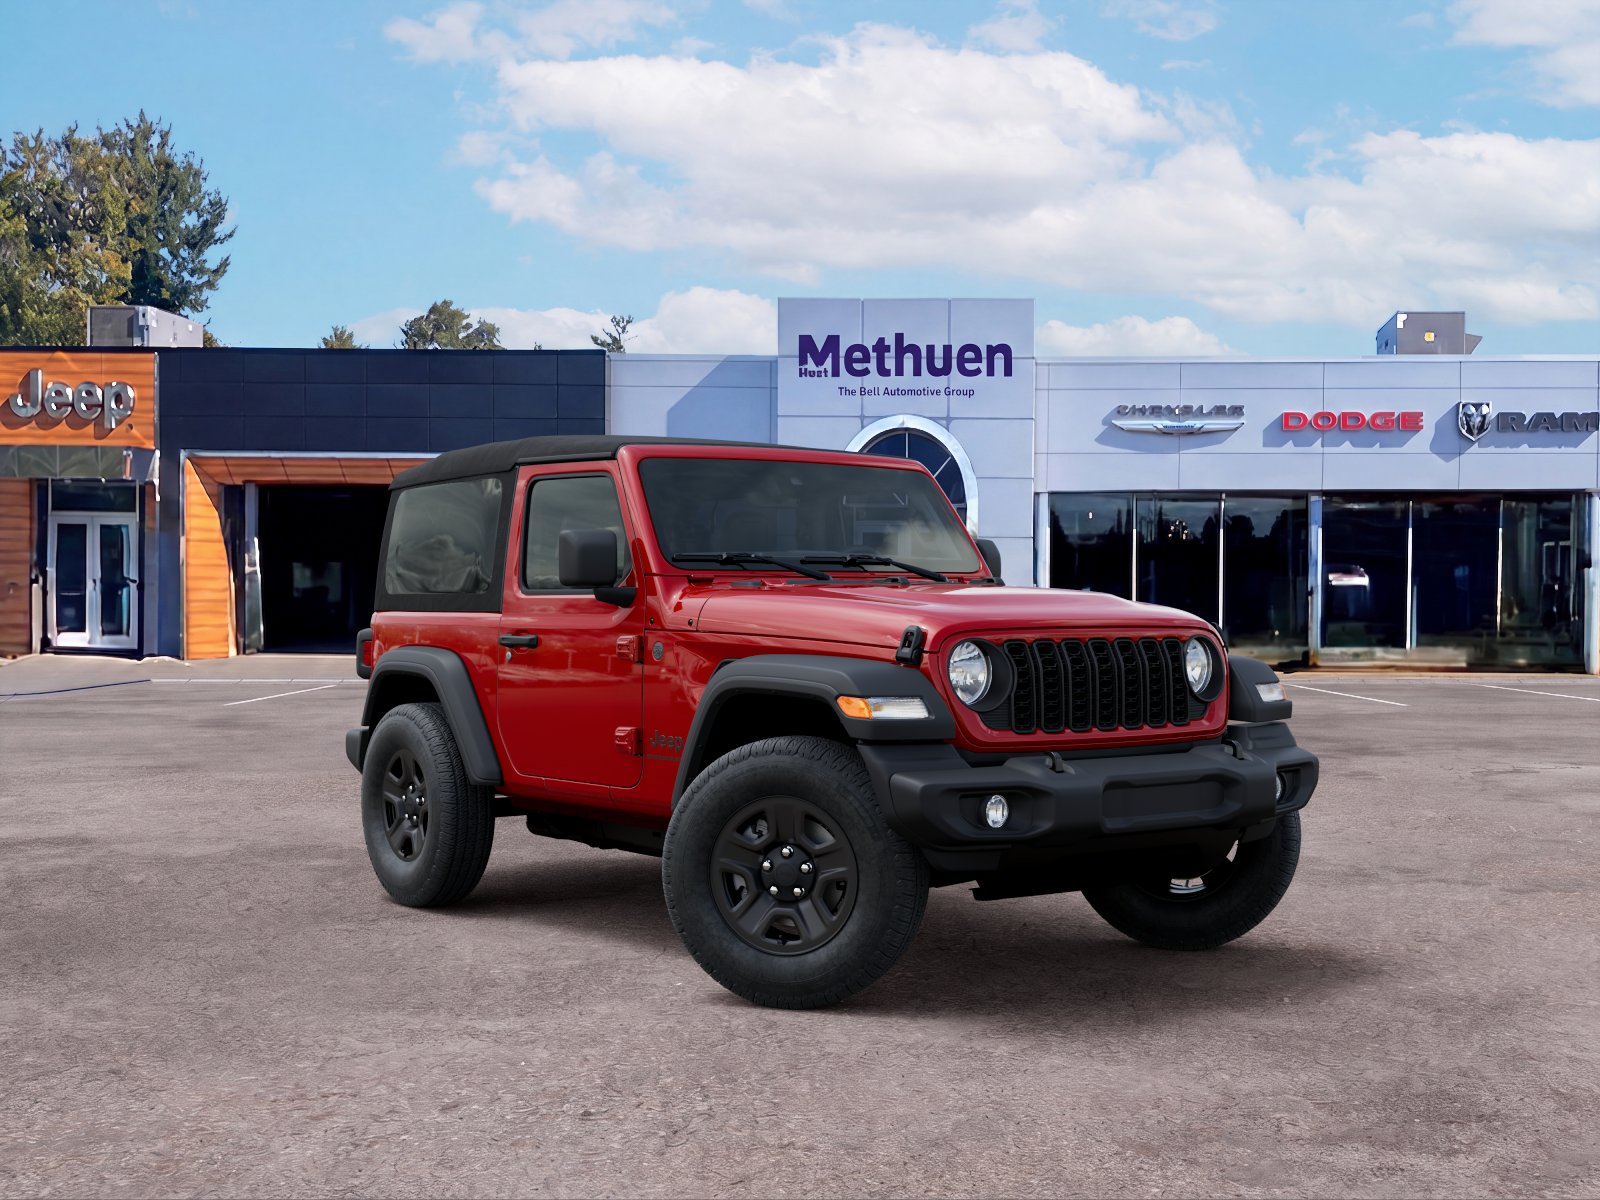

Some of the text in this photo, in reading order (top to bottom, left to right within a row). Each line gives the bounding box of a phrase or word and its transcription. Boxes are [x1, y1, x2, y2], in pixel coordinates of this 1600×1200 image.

[798, 332, 1013, 378] Methuen
[9, 368, 135, 429] Jeep
[837, 386, 975, 399] The Bell Automotive Group
[1282, 411, 1424, 431] DODGE
[1497, 411, 1599, 432] RAM
[649, 729, 684, 752] Jeep
